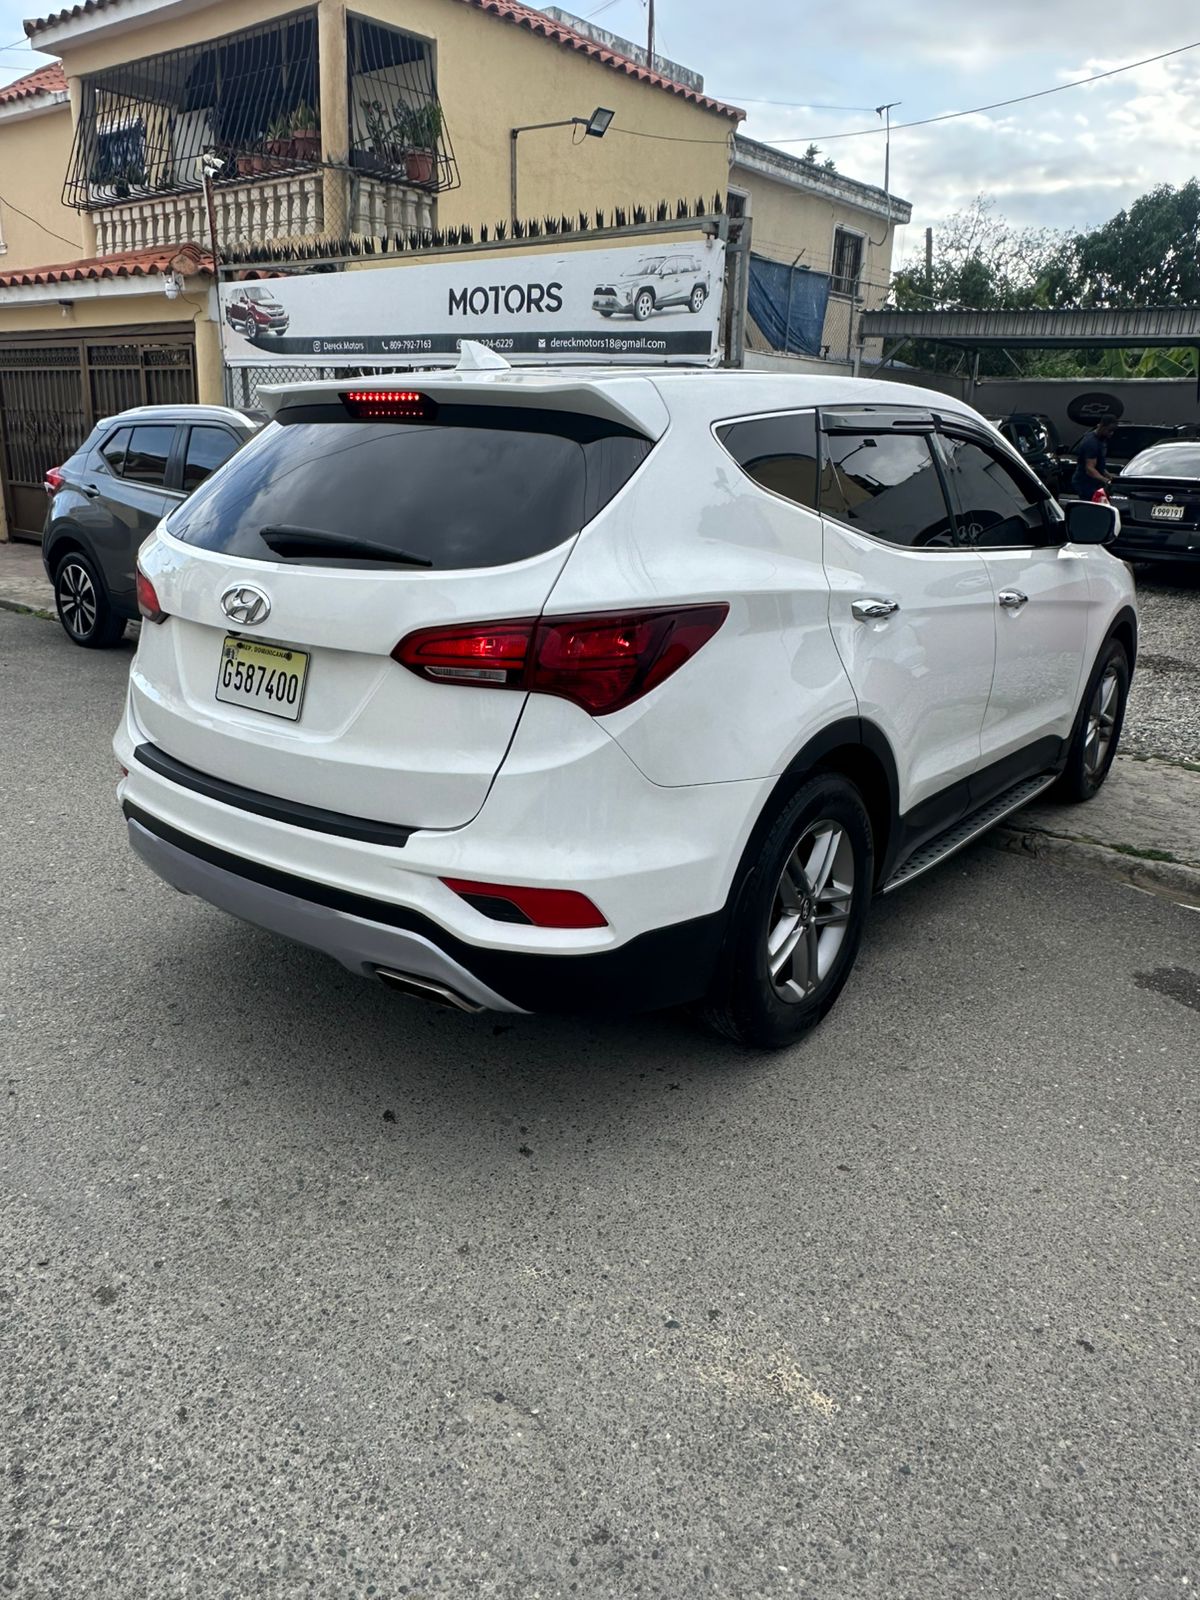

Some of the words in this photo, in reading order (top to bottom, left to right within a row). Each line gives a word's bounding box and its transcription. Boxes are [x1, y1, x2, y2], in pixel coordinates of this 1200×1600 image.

[448, 282, 563, 316] MOTORS
[343, 341, 364, 350] Motors
[389, 340, 432, 350] 809-792-7163
[550, 337, 667, 350] dereckmotors18@gmail.com
[223, 659, 299, 704] G587400
